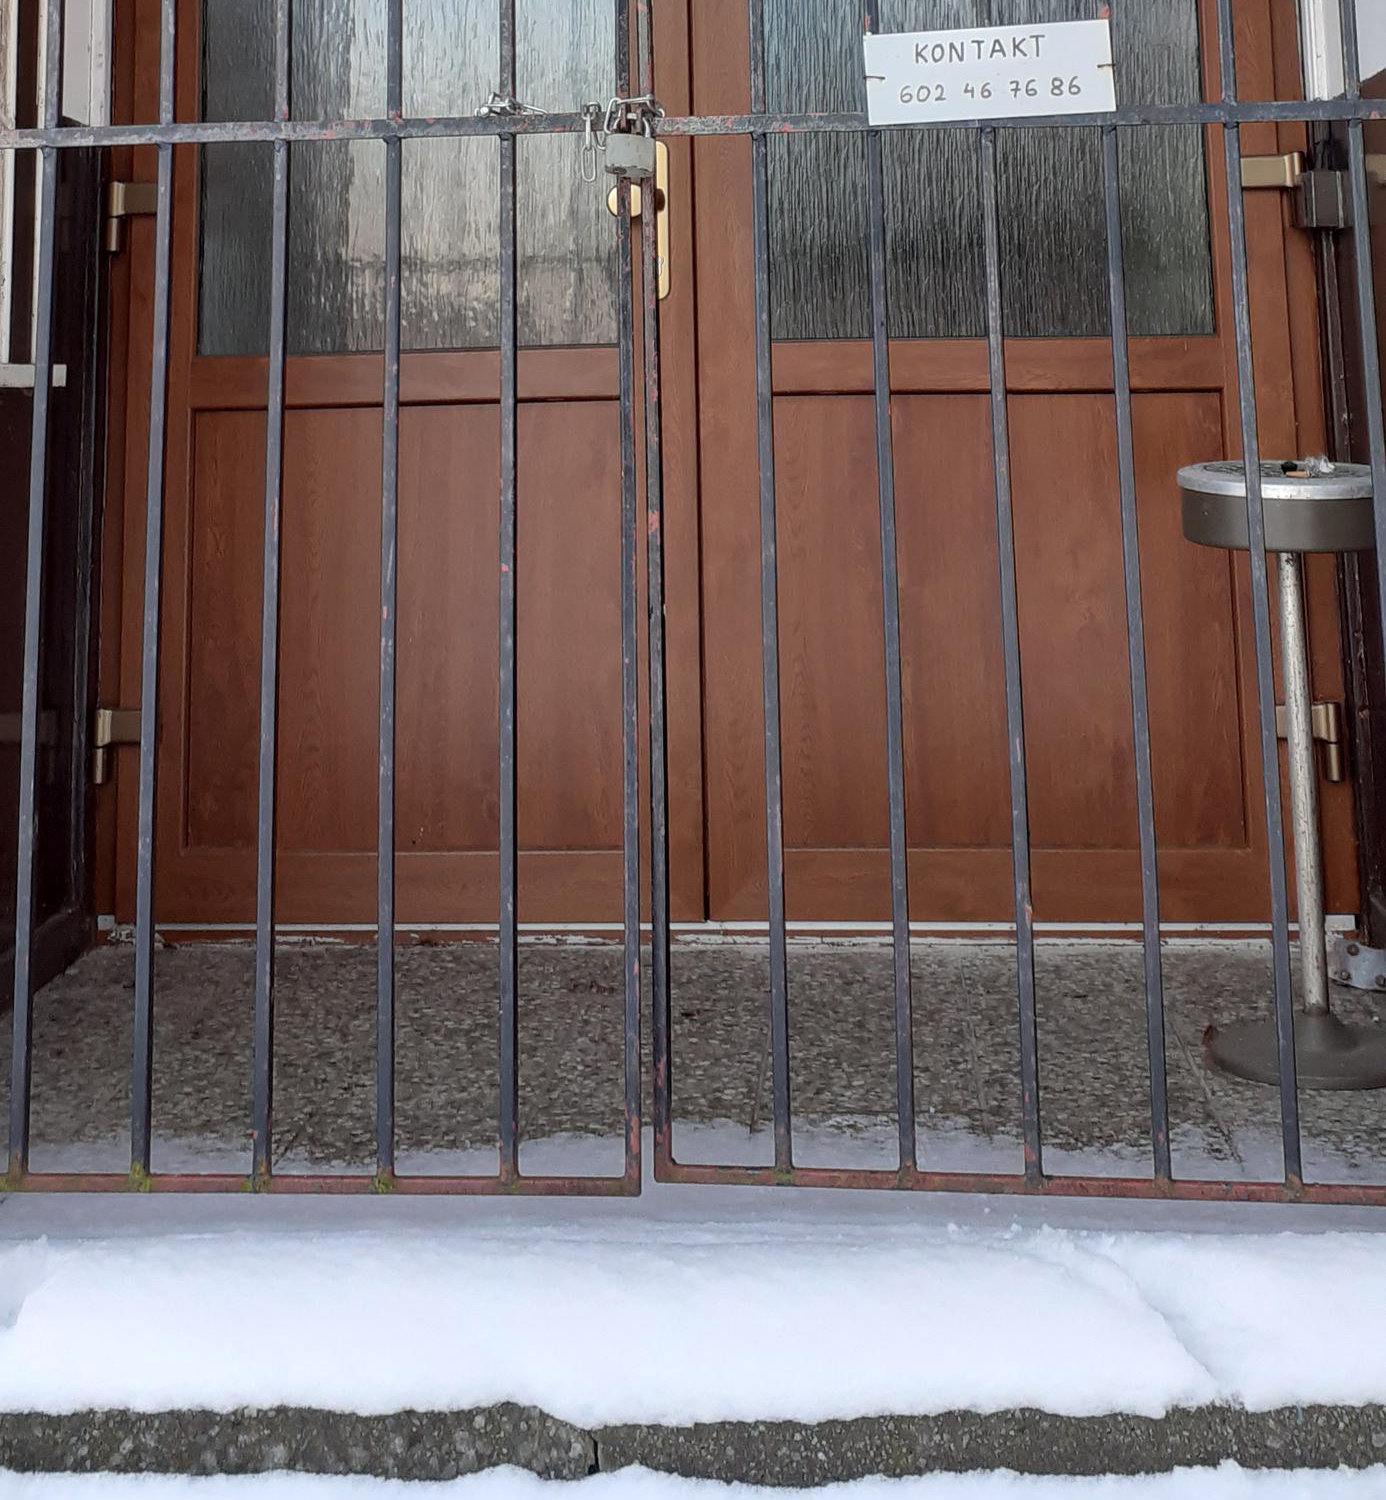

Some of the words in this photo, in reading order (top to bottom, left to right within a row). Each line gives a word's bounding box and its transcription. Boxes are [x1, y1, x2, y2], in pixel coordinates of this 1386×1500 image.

[914, 34, 1046, 64] KONTAKT
[899, 84, 947, 104] 602
[963, 82, 993, 99] 46
[1009, 79, 1038, 98] 76
[1049, 75, 1082, 96] 86
